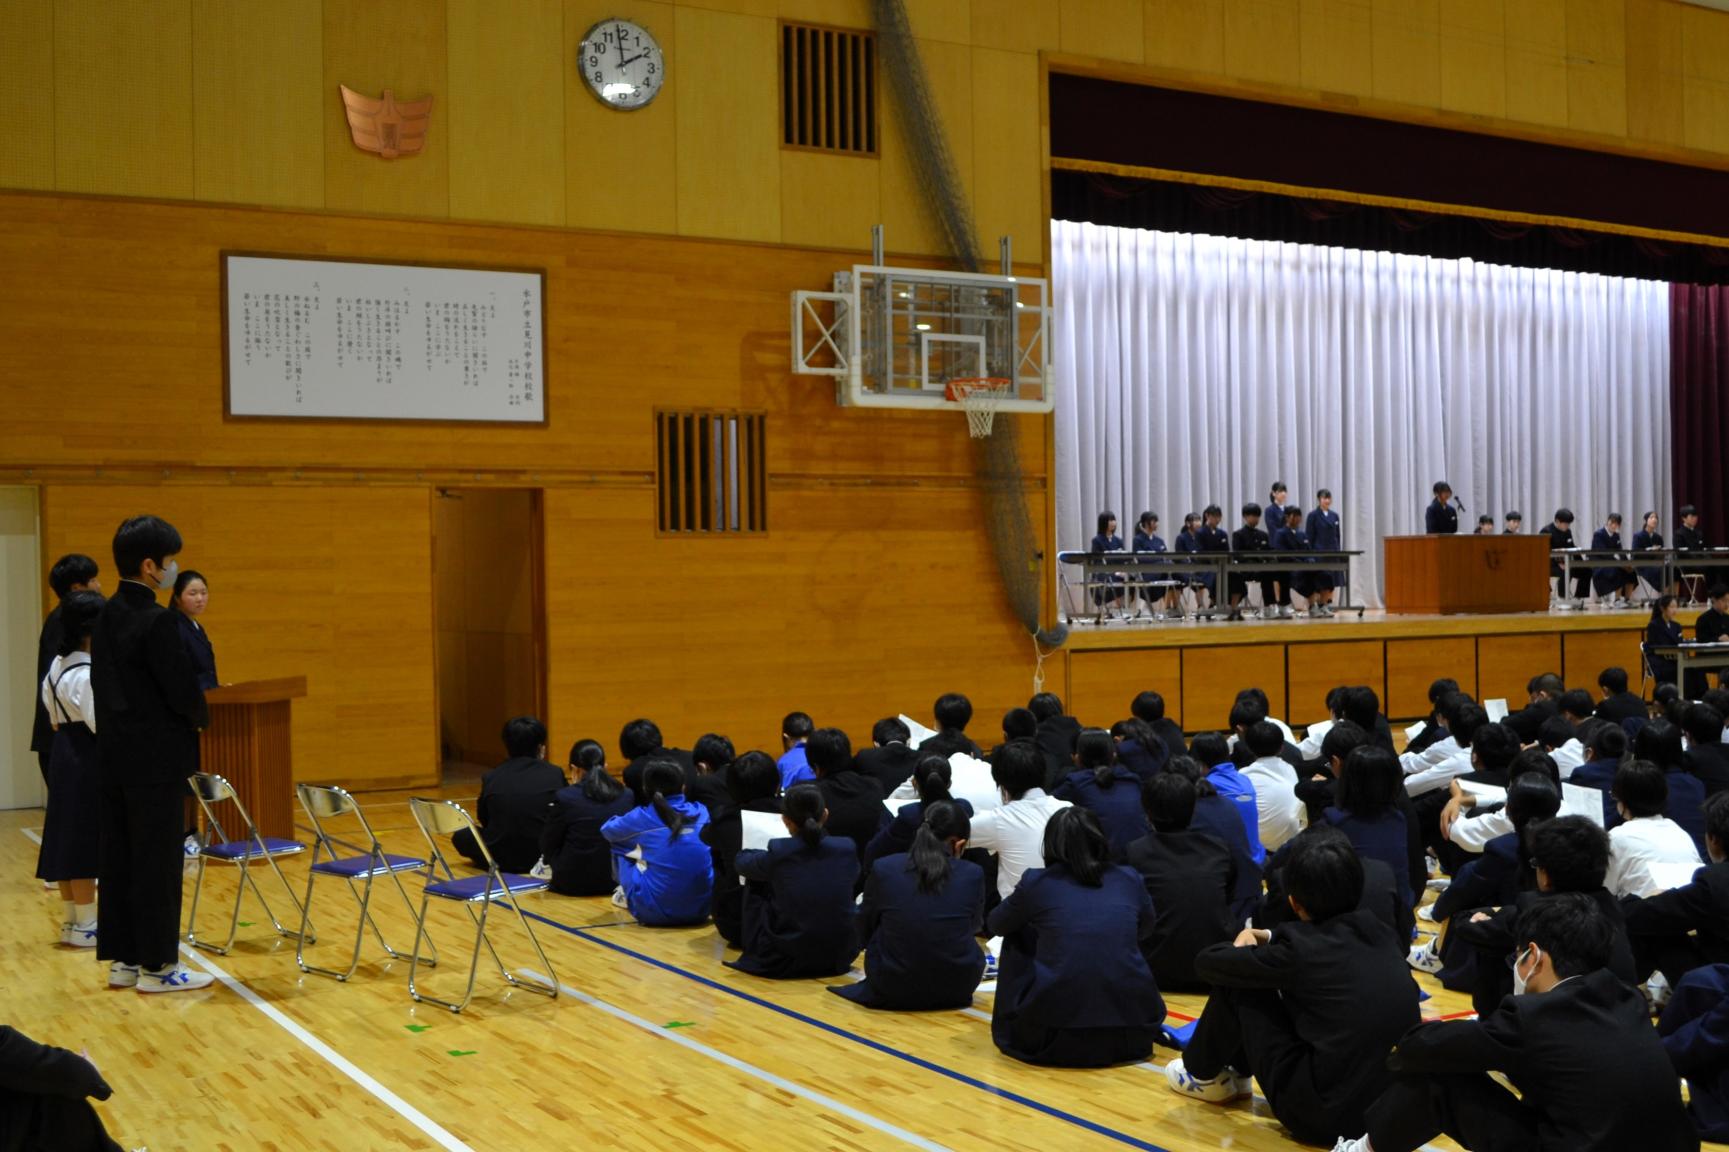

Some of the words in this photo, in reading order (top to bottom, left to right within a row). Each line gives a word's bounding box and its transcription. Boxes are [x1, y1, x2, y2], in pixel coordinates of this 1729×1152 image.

[602, 32, 614, 44] 11
[634, 36, 640, 47] 1
[593, 42, 606, 54] 10
[643, 47, 651, 58] 2
[590, 56, 598, 67] 9
[647, 63, 656, 74] 3
[594, 71, 603, 83] 8
[643, 77, 650, 88] 4
